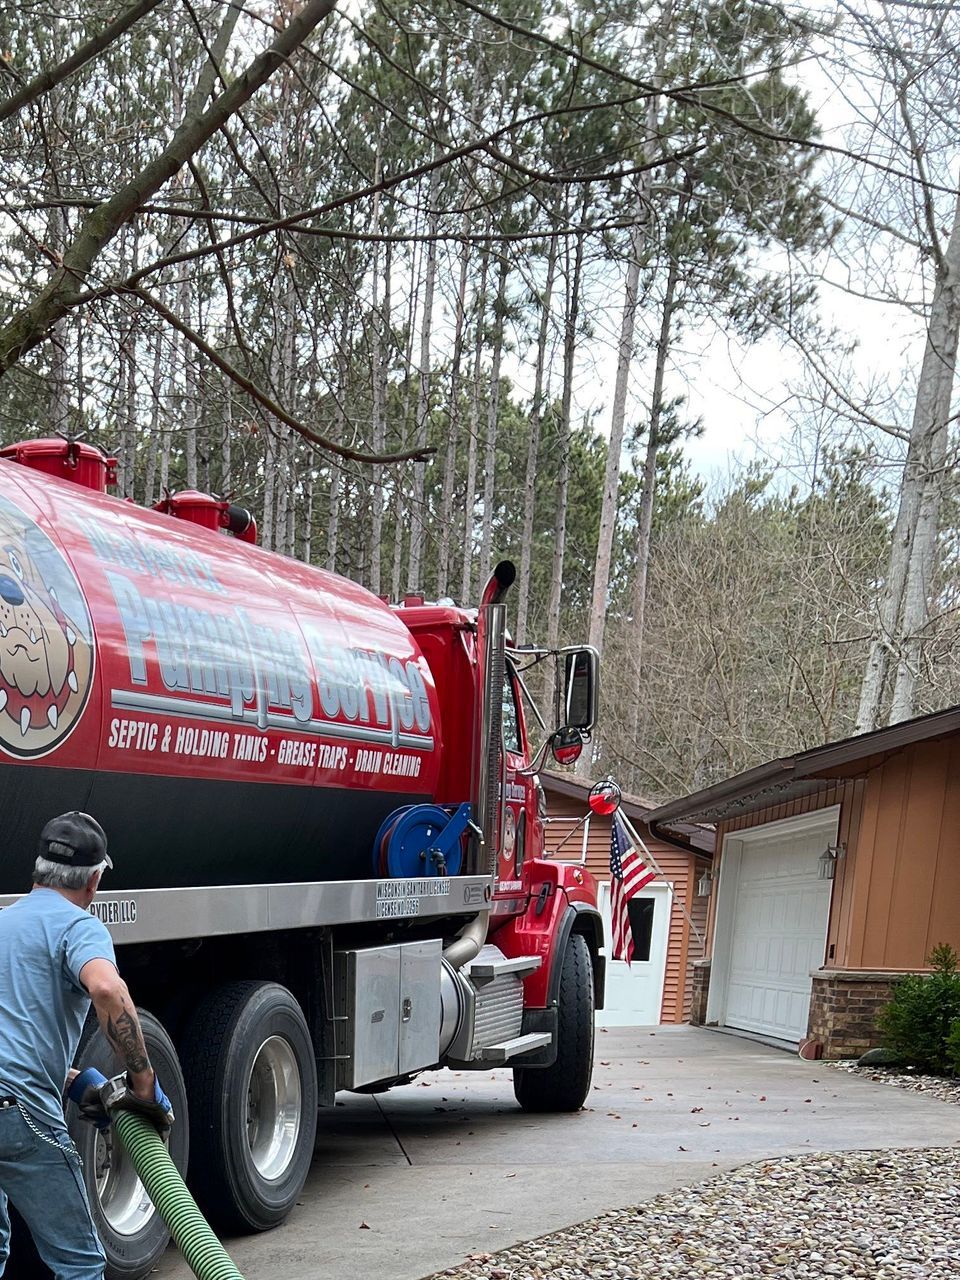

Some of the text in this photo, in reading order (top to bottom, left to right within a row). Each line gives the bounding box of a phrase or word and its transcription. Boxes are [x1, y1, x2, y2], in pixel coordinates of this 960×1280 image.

[71, 511, 228, 596] Maverick
[104, 568, 431, 749] Pumping Service
[108, 718, 159, 751] SEPTIC
[161, 724, 172, 753] &
[176, 726, 230, 759] HOLDING
[233, 733, 269, 763] TANKS
[277, 739, 315, 767] GREASE
[318, 744, 348, 771] TRAPS
[354, 749, 381, 774] DRAIN
[382, 752, 422, 777] CLEANING
[121, 899, 137, 923] LLC
[376, 882, 406, 899] WISCONSIN
[376, 900, 397, 918] LICENSE
